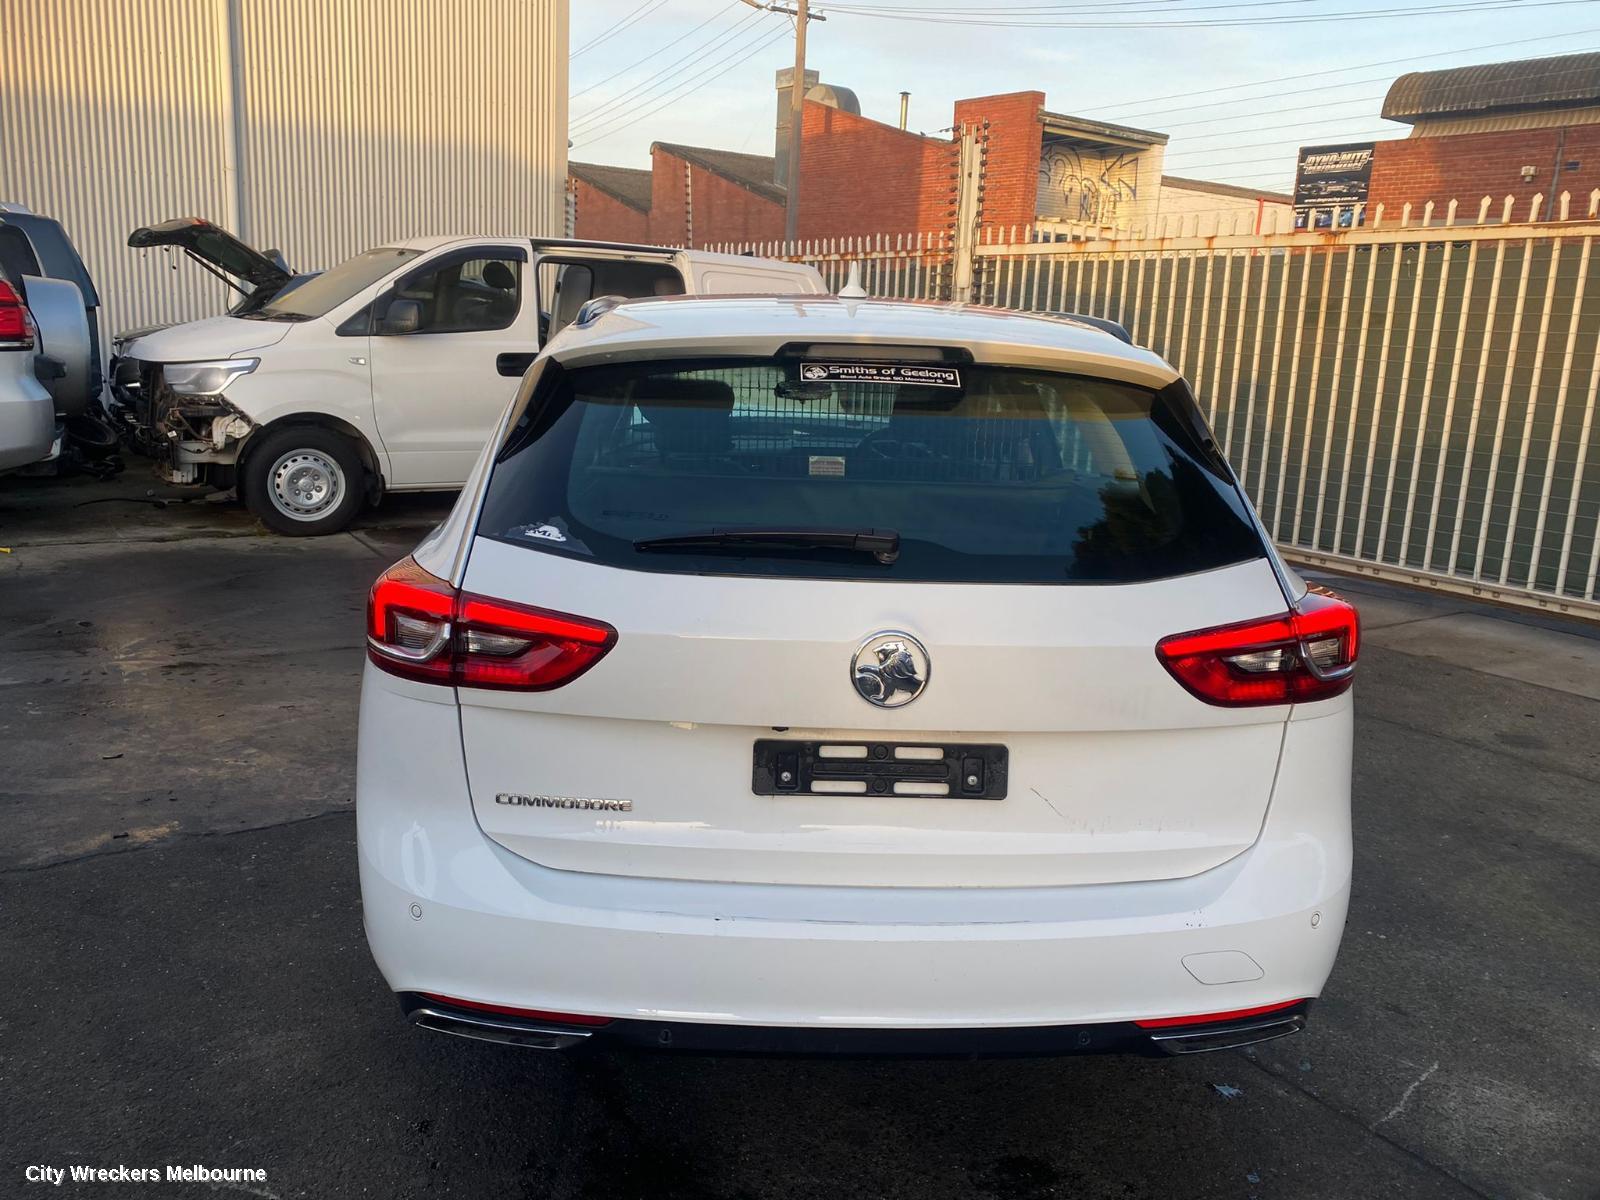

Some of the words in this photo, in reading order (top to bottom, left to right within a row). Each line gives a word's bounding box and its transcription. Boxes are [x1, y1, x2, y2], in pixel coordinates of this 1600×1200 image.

[1306, 152, 1370, 166] DYNO-MITE
[1306, 162, 1362, 172] PERFORMANCE
[829, 365, 877, 374] Smiths
[883, 367, 896, 375] of
[900, 368, 954, 380] Geelong
[495, 793, 632, 812] COMMODORE
